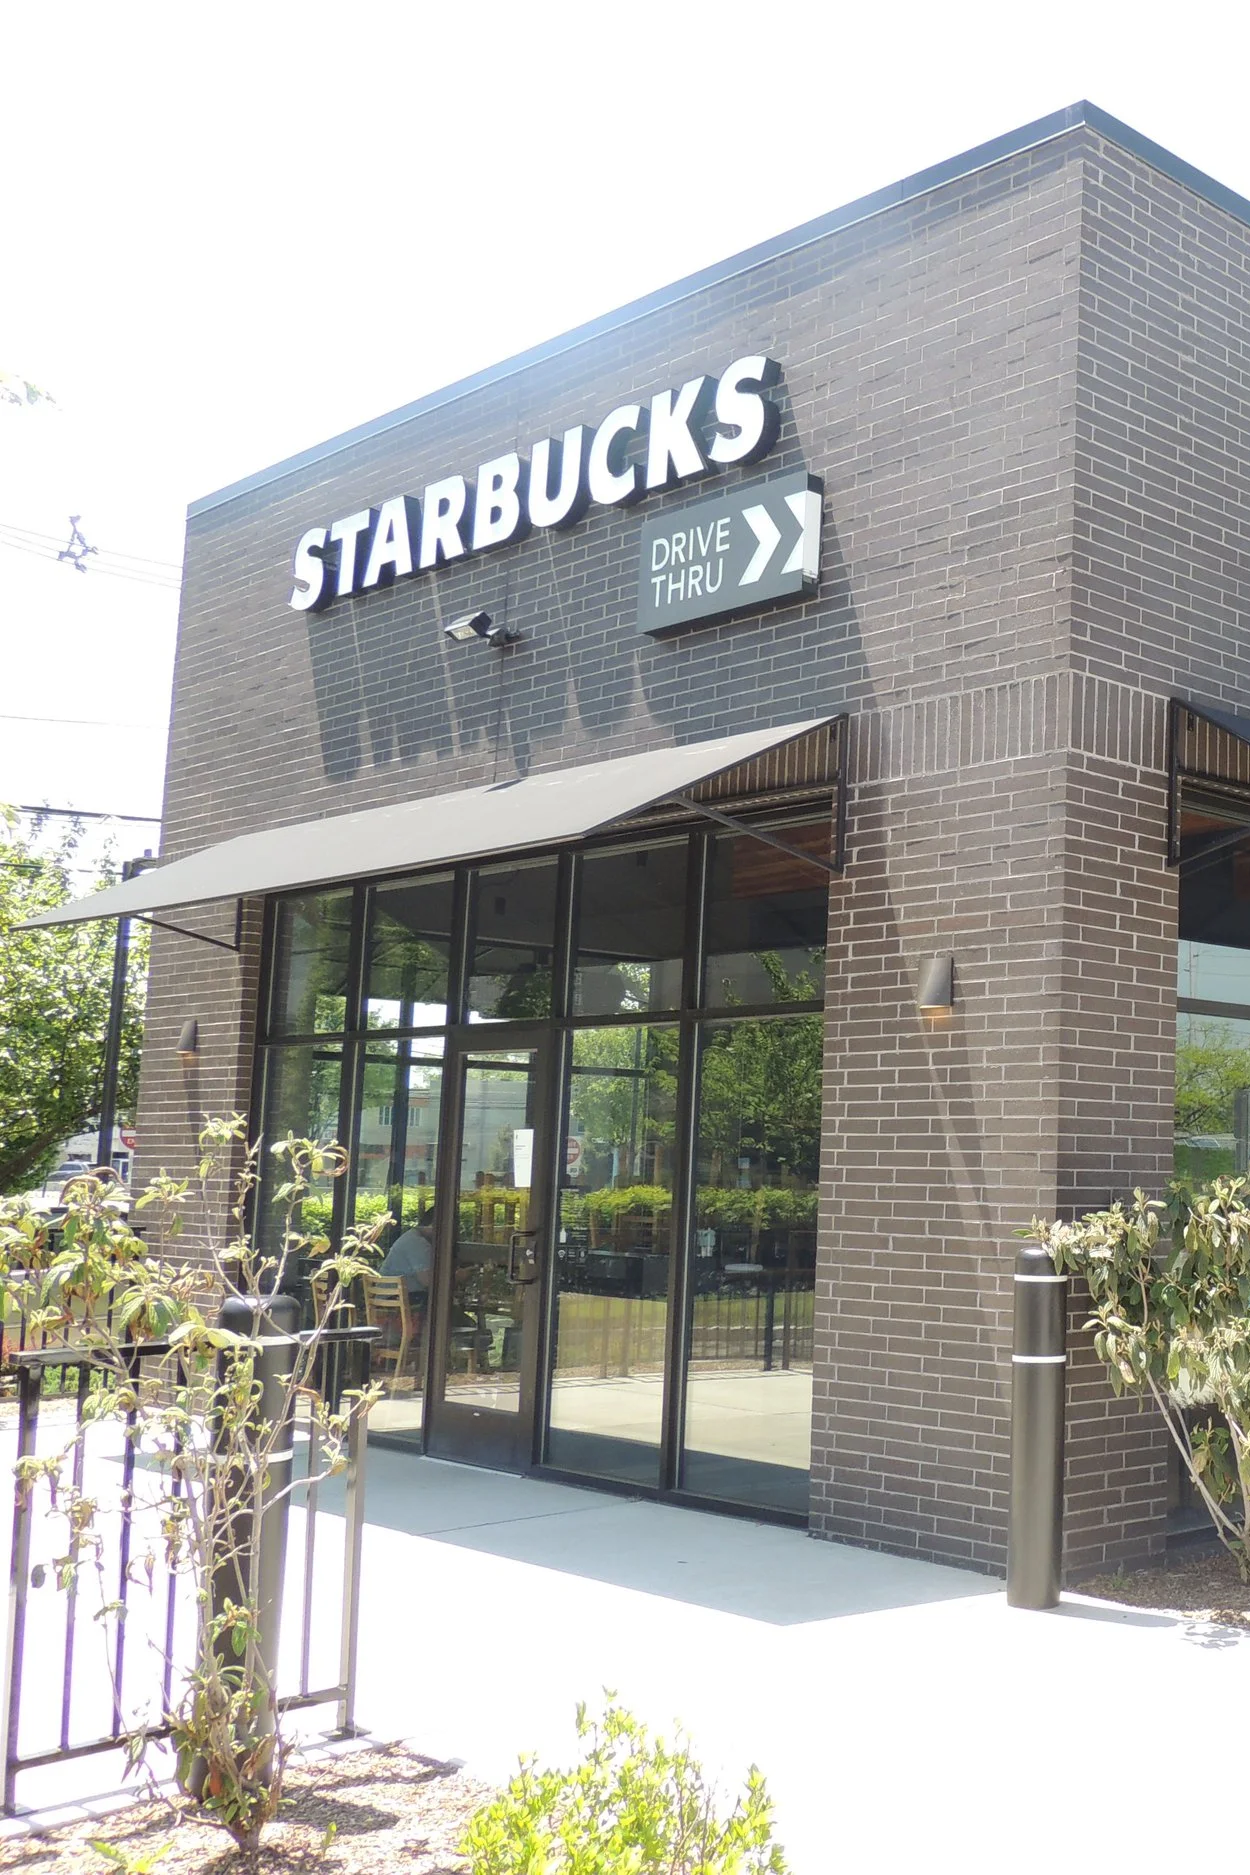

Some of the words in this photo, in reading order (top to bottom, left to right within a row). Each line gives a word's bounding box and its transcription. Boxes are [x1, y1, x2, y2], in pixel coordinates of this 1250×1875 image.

[288, 355, 770, 612] STARBUCKS
[651, 516, 731, 572] DRIVE
[650, 557, 724, 608] THRU
